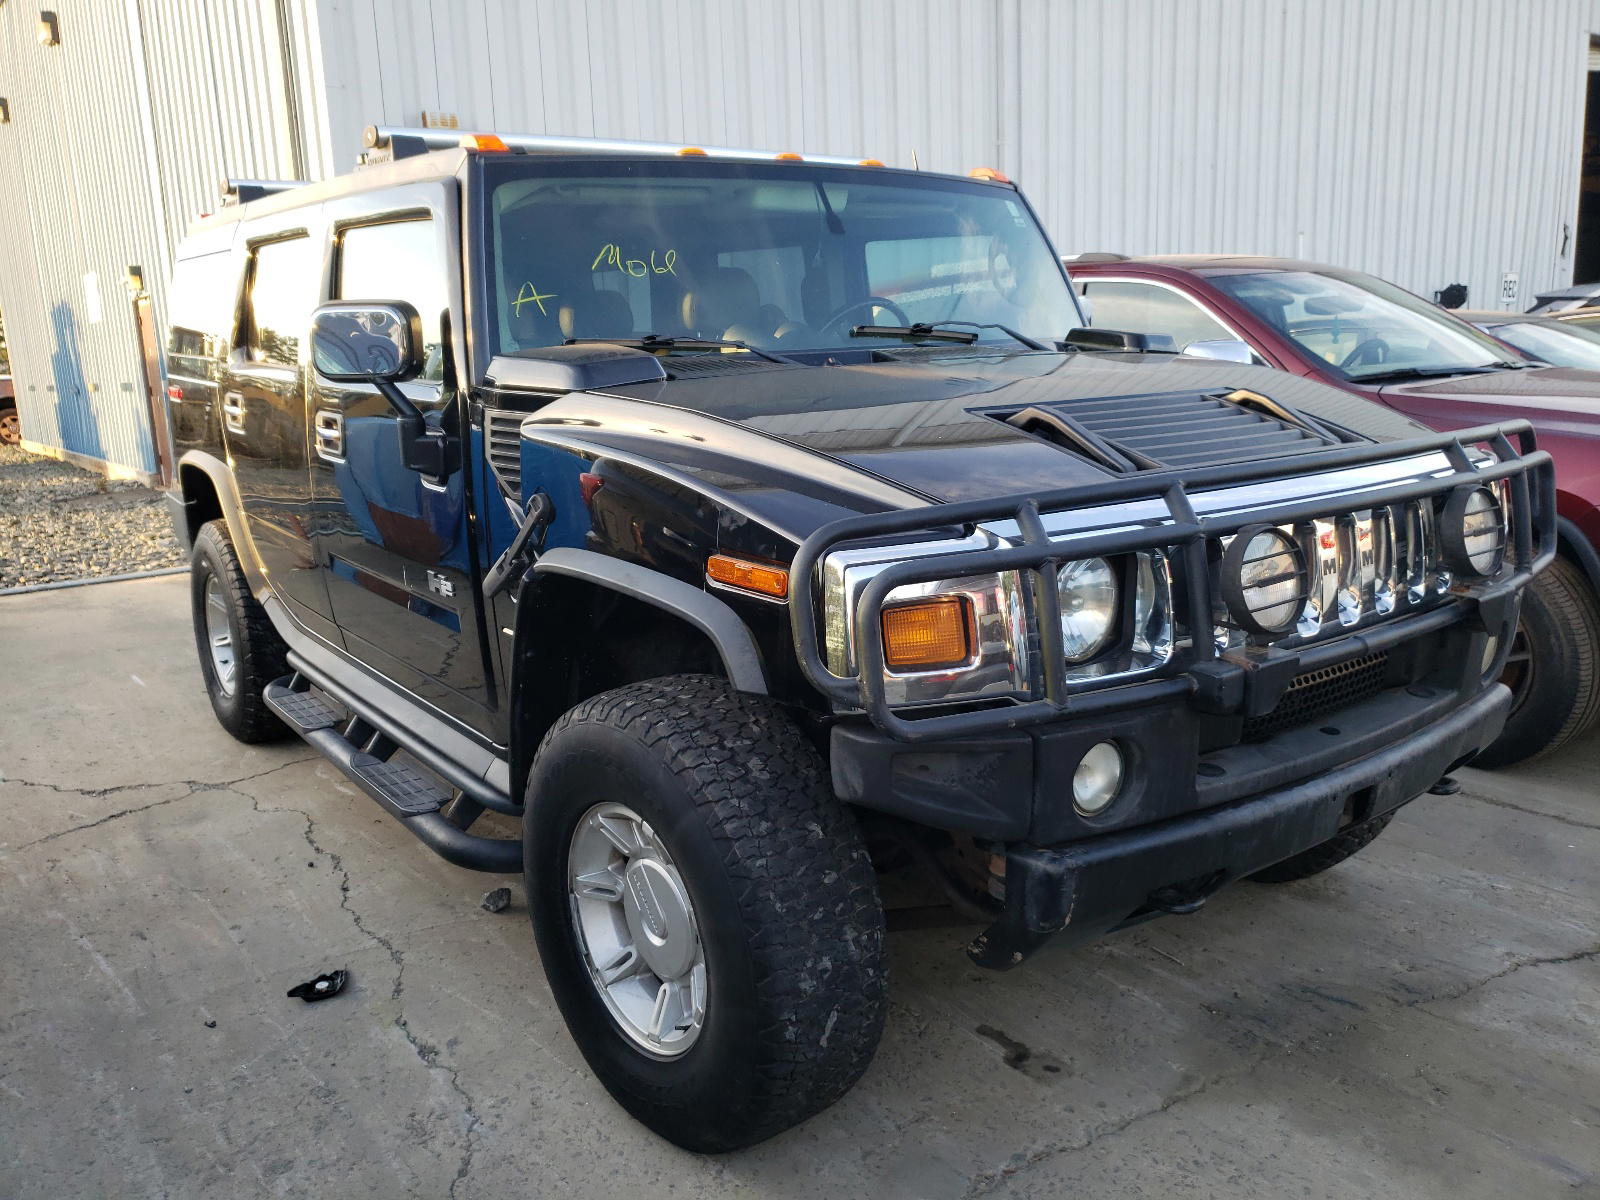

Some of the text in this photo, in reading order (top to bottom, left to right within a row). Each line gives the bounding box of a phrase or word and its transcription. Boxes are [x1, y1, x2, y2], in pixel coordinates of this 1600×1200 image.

[511, 280, 558, 318] A
[1322, 549, 1374, 576] M M
[426, 569, 453, 598] H2
